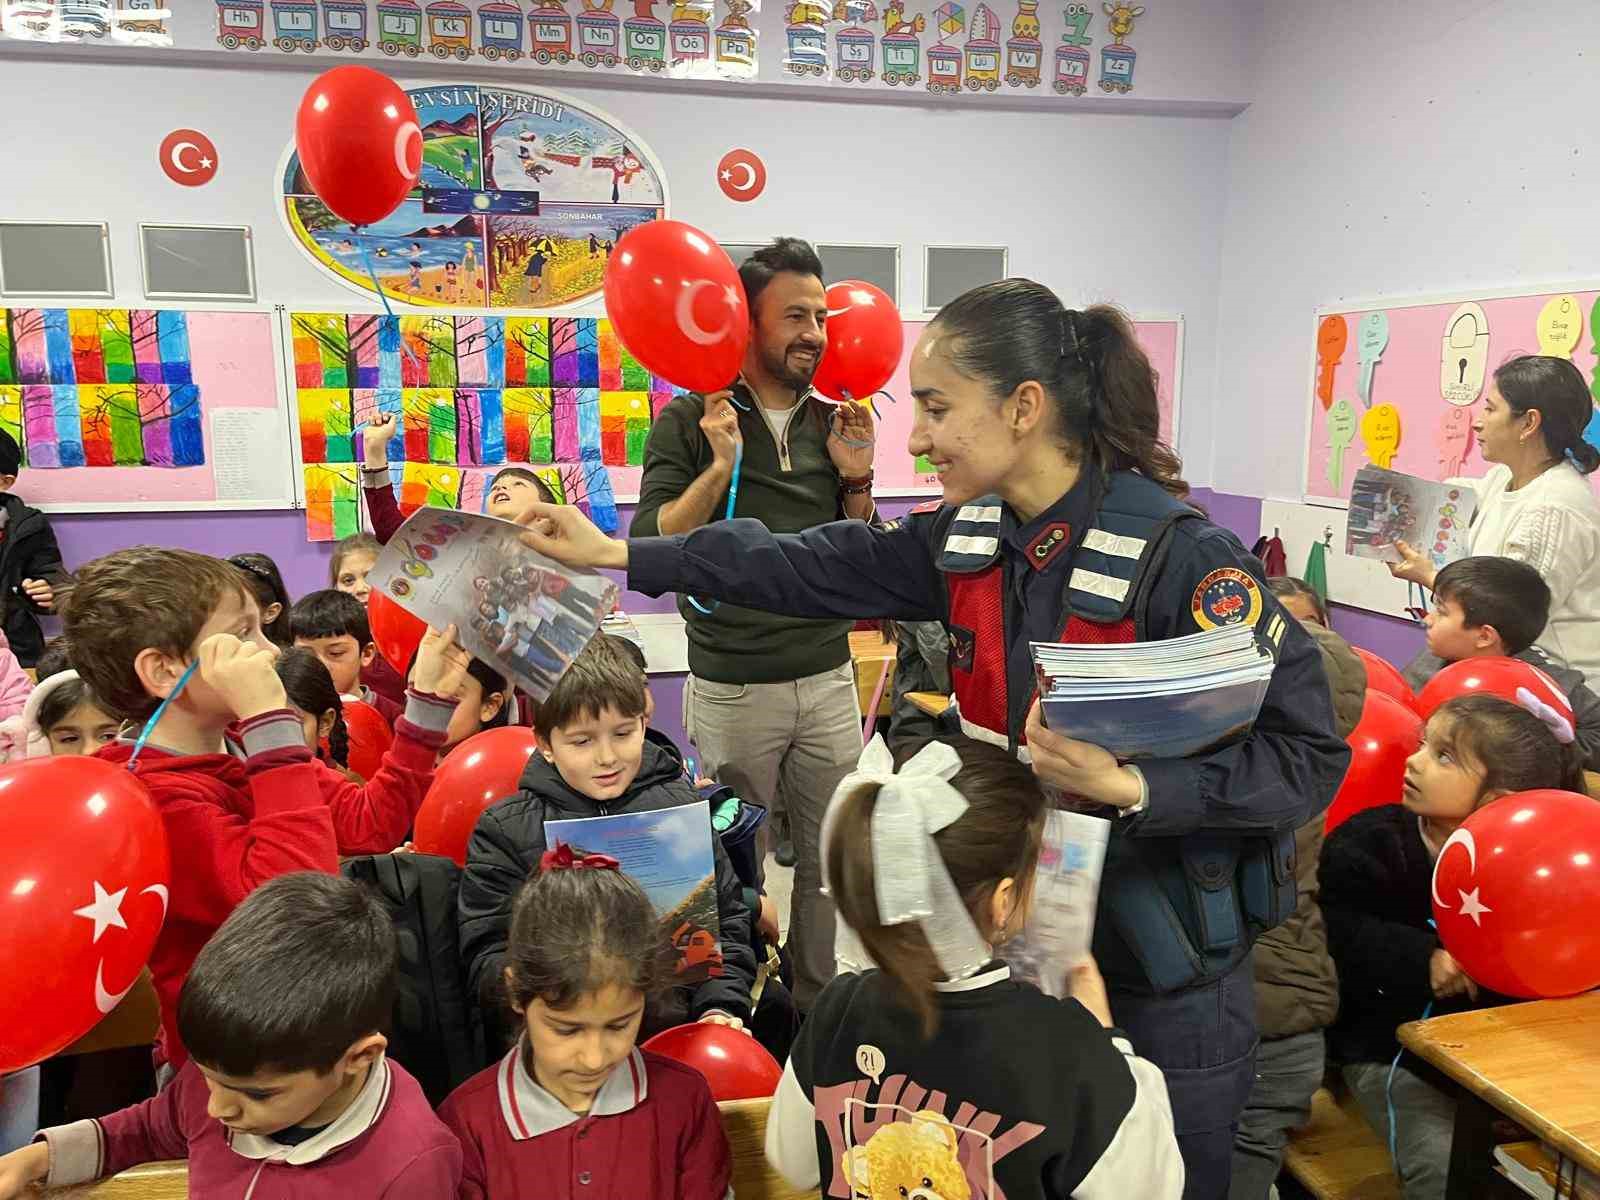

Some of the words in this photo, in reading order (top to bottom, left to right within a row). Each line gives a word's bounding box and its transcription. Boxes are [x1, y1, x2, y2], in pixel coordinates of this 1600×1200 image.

[232, 10, 250, 23] Hh
[395, 17, 407, 33] Jj
[443, 19, 460, 32] Kk
[492, 21, 505, 34] Ll
[539, 25, 561, 38] Mm
[591, 28, 609, 41] Nn
[635, 32, 655, 45] Oo
[727, 40, 744, 54] Pp
[894, 47, 905, 60] Tt
[1016, 52, 1032, 64] Vv
[936, 59, 951, 72] Uu
[1065, 61, 1080, 73] Yy
[1111, 59, 1125, 71] Zz
[409, 87, 481, 110] EVSİM
[488, 92, 567, 122] ŞERİDİ
[558, 211, 603, 221] SONBAHAR
